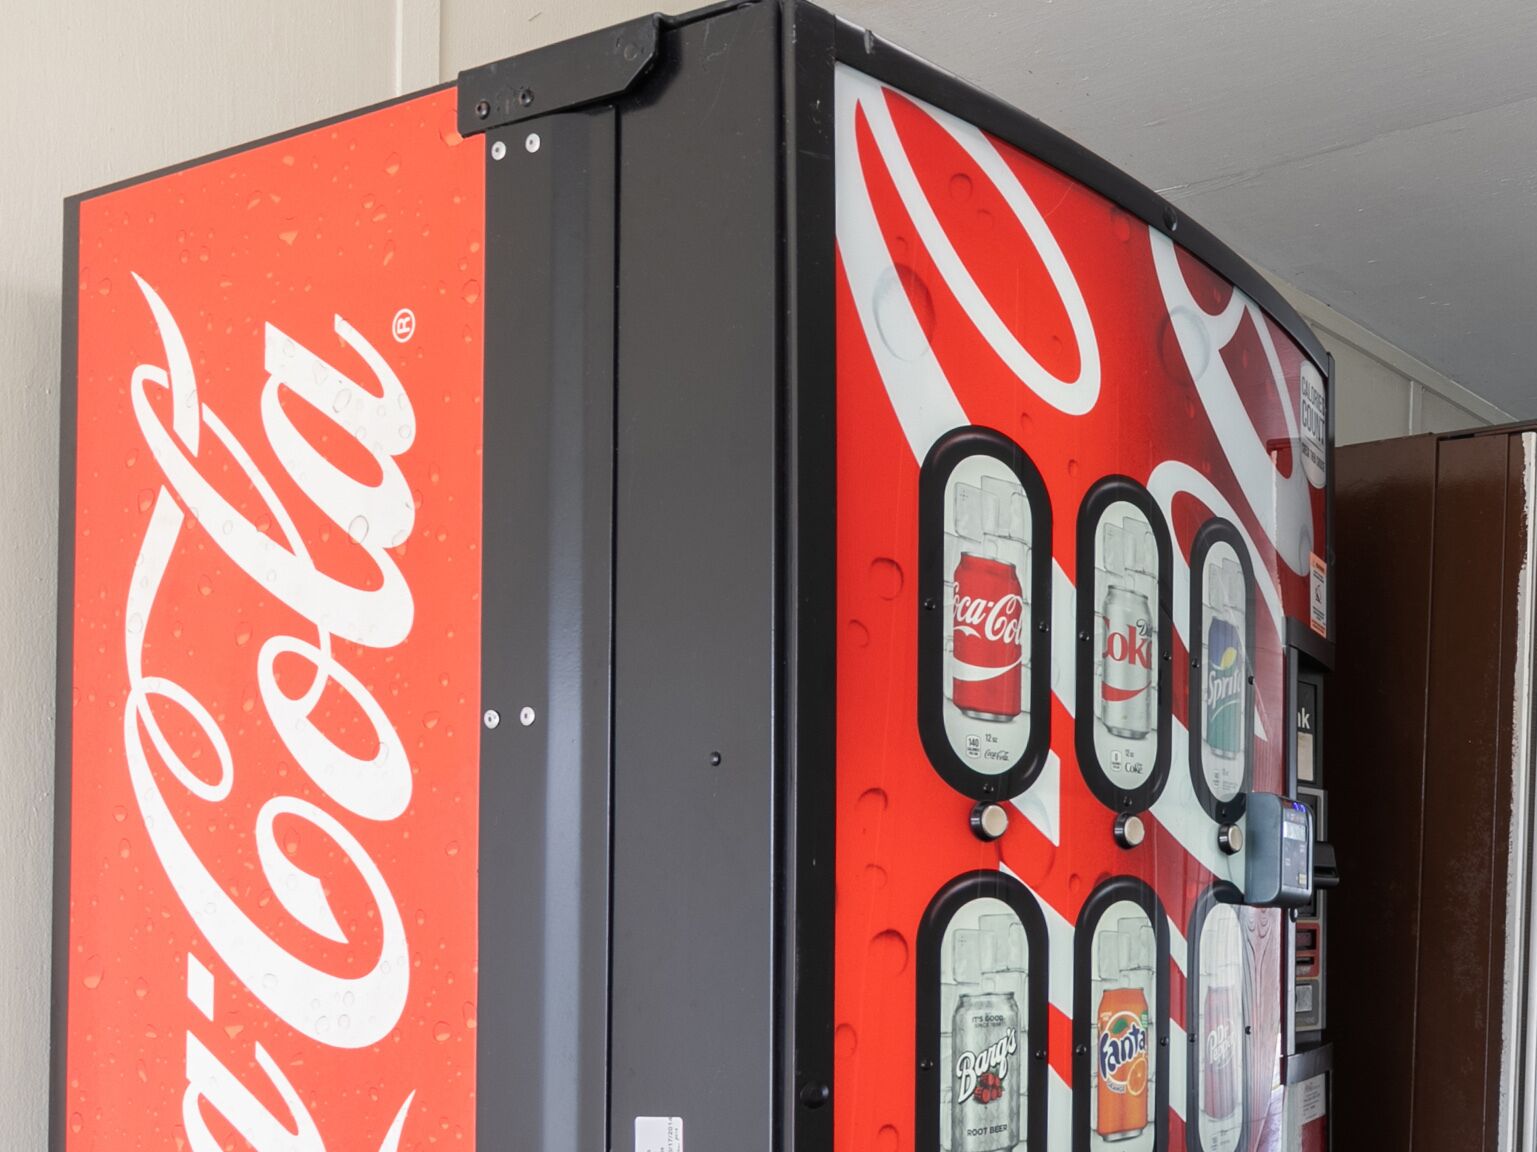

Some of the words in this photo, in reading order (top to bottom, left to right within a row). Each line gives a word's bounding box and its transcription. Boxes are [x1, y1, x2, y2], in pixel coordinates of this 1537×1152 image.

[956, 1026, 1017, 1104] Barq's
[966, 1126, 987, 1137] ROOT
[989, 1123, 1009, 1134] BEER
